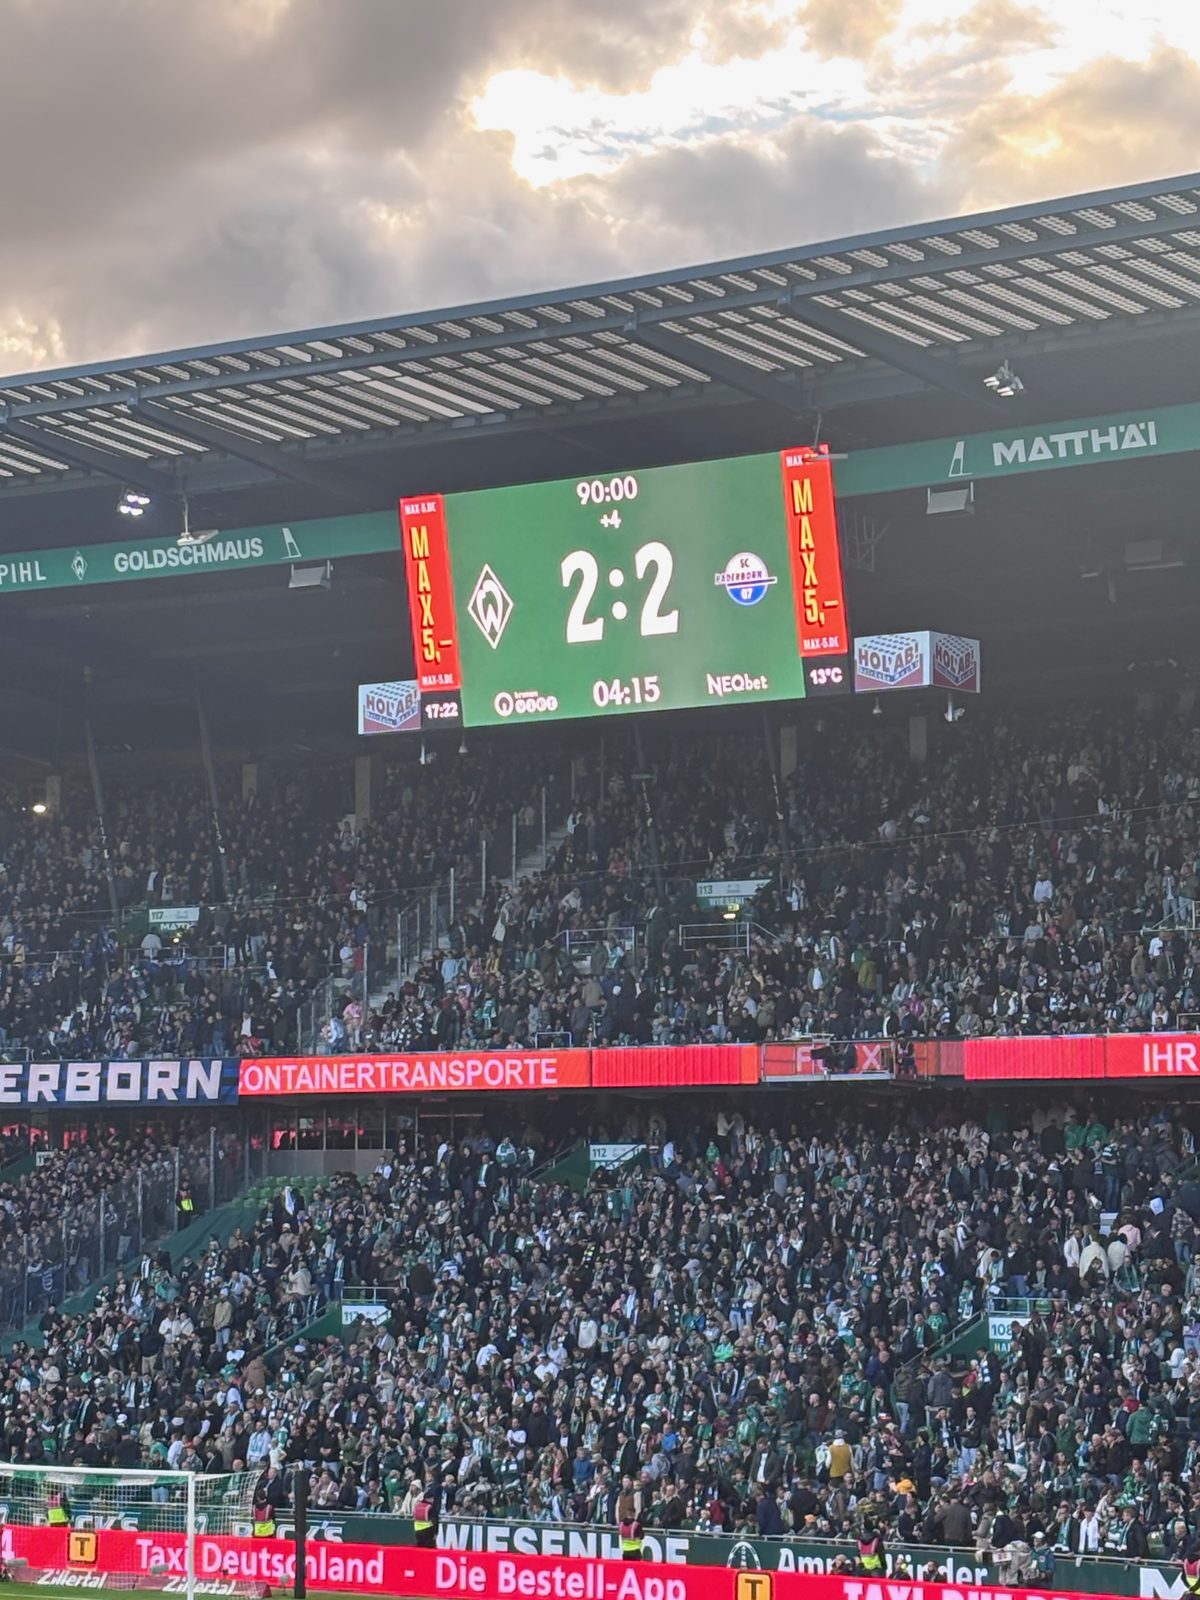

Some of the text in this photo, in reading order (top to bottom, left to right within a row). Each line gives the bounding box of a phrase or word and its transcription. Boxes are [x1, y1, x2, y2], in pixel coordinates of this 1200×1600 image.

[992, 421, 1157, 466] MATTHÄI
[576, 475, 638, 505] 90:00
[600, 509, 622, 528] +4
[114, 537, 264, 573] GOLDSCHMAUS
[0, 560, 47, 585] PIHL
[810, 666, 843, 685] 13°C
[593, 675, 661, 707] 04:15
[425, 702, 458, 719] 17:22
[1143, 1042, 1199, 1072] IHR
[0, 1060, 222, 1102] ERBORN
[239, 1058, 557, 1091] ONTAINERTRANSPORTE
[37, 1568, 109, 1588] Zillertal
[135, 1538, 189, 1571] Taxi
[436, 1556, 487, 1593] Die
[498, 1559, 687, 1600] Bestell-App
